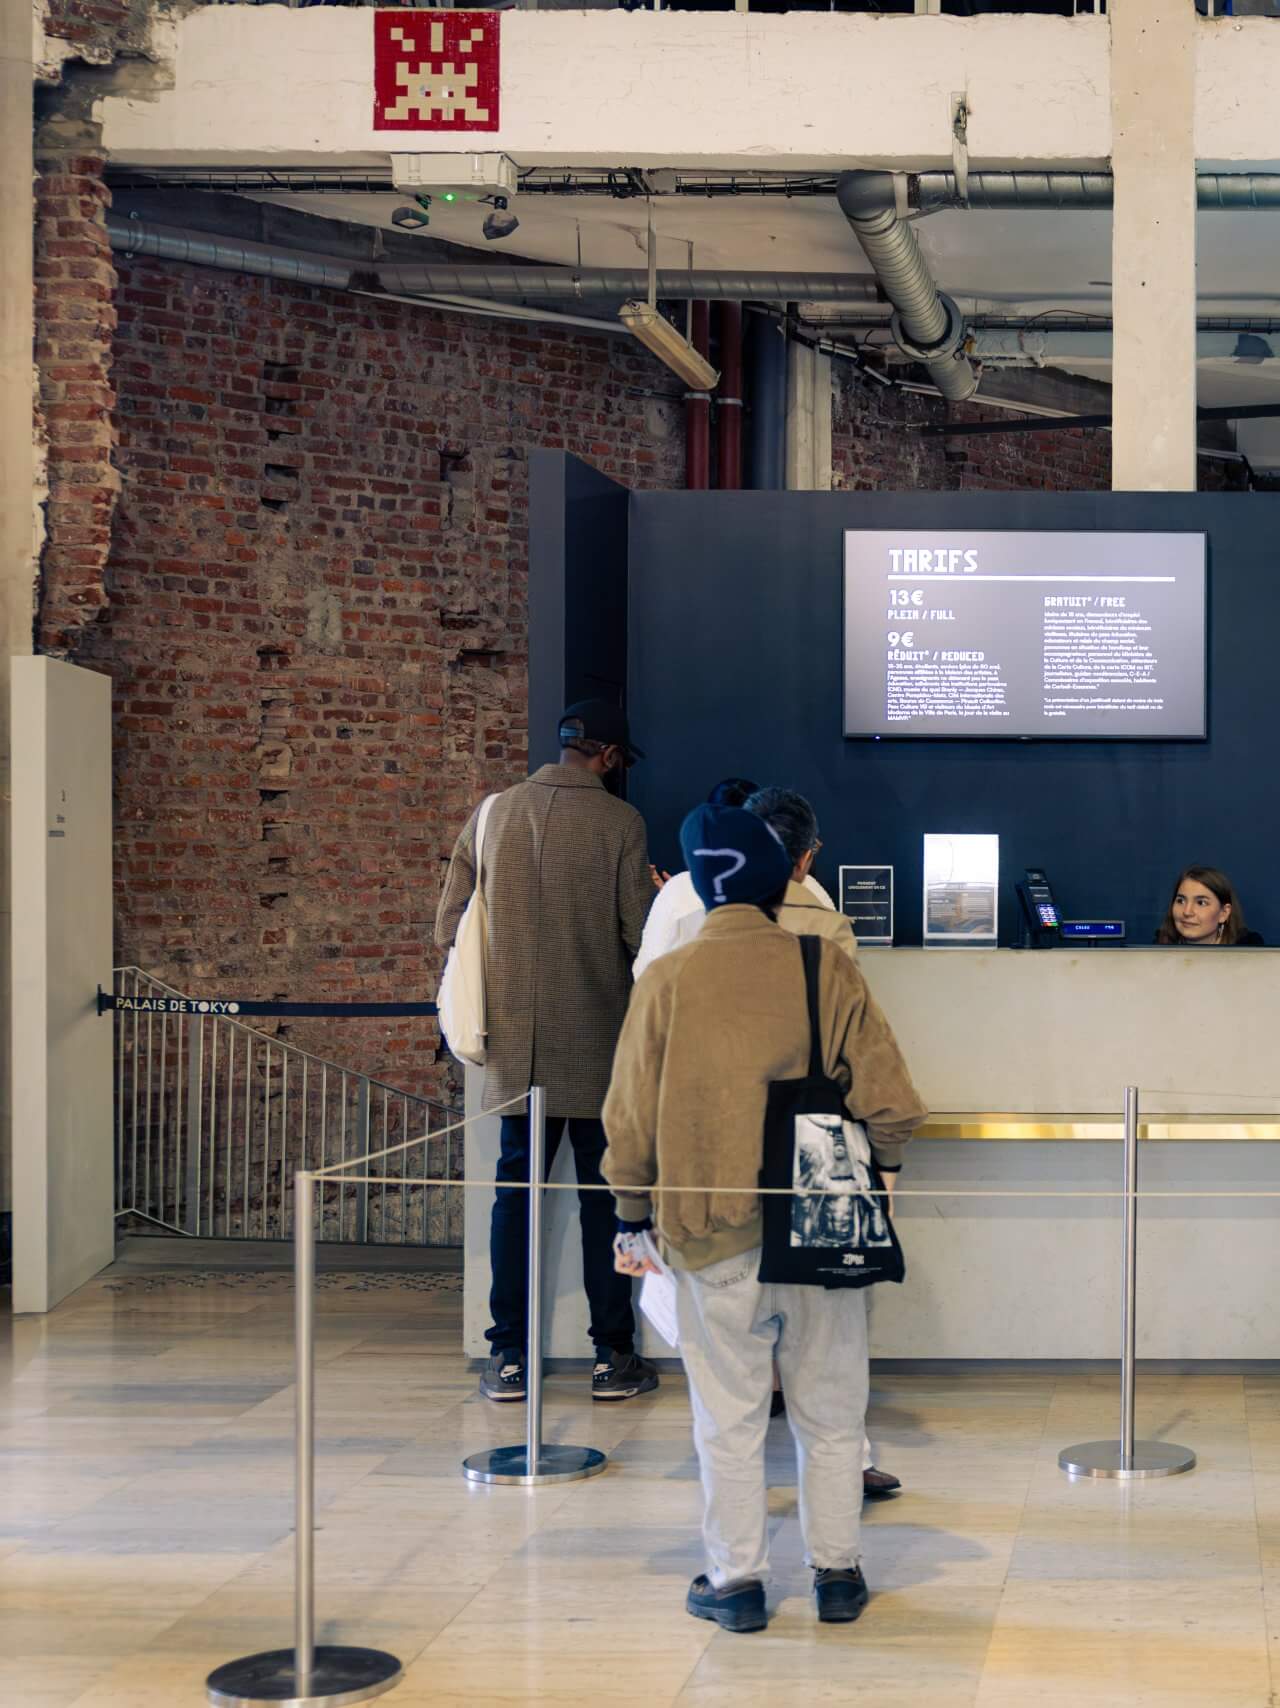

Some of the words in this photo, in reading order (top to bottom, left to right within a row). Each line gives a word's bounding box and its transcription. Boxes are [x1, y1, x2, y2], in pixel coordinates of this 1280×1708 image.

[888, 549, 978, 573] TARIFS
[889, 590, 923, 605] 13€
[1101, 597, 1126, 607] FREE
[888, 610, 920, 620] PLEIN
[930, 610, 955, 620] FULL
[888, 632, 914, 647] 9€
[941, 652, 985, 661] REDUCED
[116, 998, 166, 1010] PALAIS
[170, 1000, 187, 1012] DE
[190, 1001, 239, 1014] TOKYO
